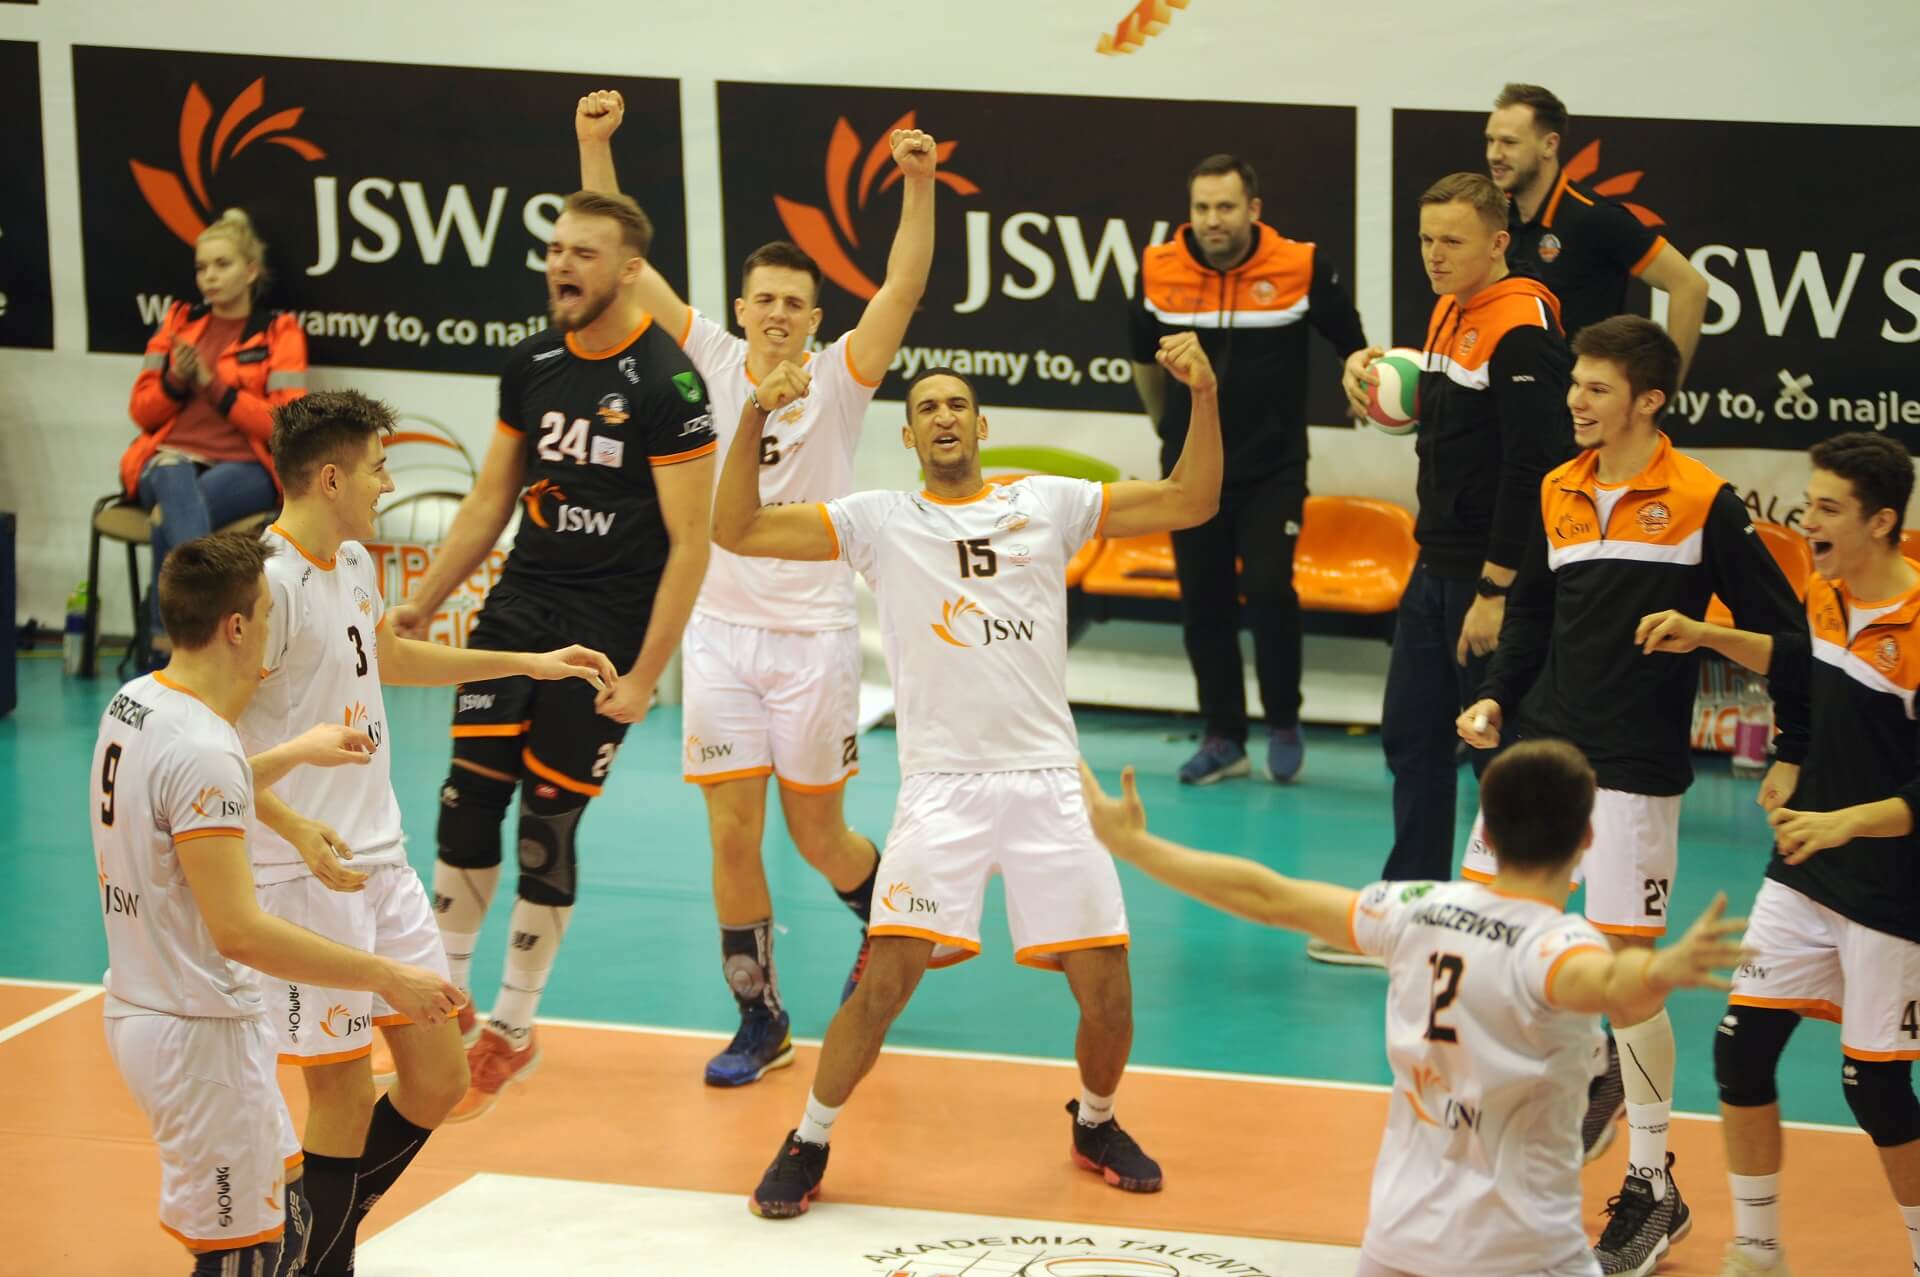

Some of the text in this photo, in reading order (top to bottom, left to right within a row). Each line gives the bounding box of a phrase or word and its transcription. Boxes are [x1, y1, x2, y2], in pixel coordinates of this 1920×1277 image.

[306, 176, 566, 277] JSW S
[953, 210, 1170, 314] JSW
[1881, 258, 1920, 343] S
[384, 311, 430, 348] to,
[436, 318, 478, 346] co
[1034, 350, 1082, 386] to,
[1088, 356, 1132, 384] co
[1717, 388, 1765, 424] to,
[1829, 391, 1920, 431] najle
[538, 411, 590, 465] 24
[555, 503, 616, 536] JSW
[953, 538, 997, 578] 15
[347, 625, 368, 677] 3
[982, 619, 1035, 646] JSW
[592, 742, 616, 778] 2
[700, 743, 733, 762] JSW
[101, 743, 123, 827] 9
[105, 884, 140, 918] JSW
[909, 897, 940, 915] JSW
[863, 1236, 1272, 1277] AKADEMIA TALENT
